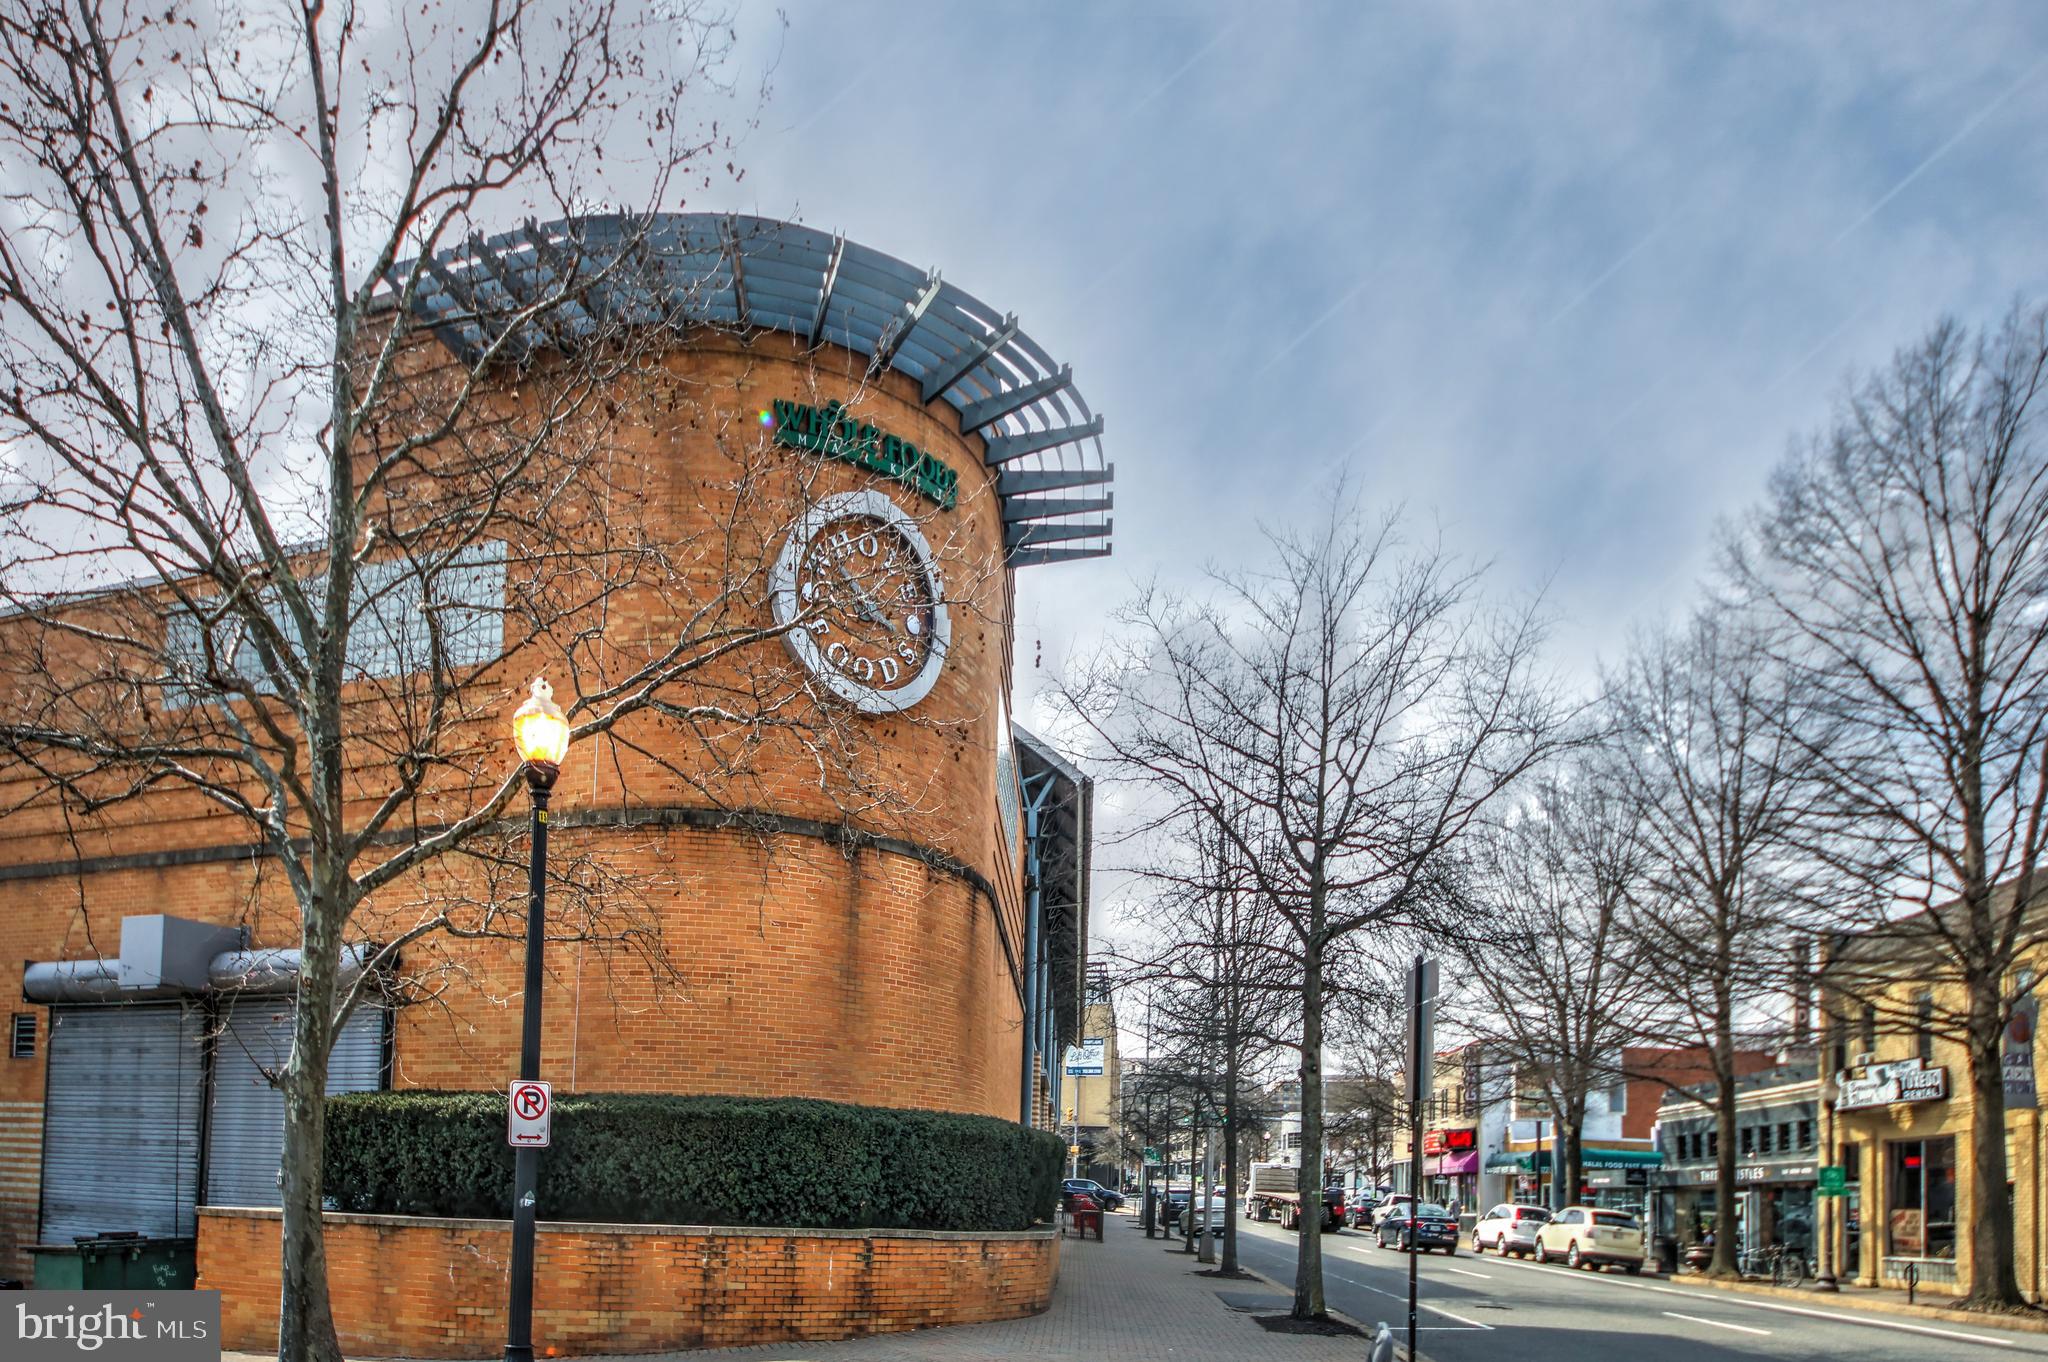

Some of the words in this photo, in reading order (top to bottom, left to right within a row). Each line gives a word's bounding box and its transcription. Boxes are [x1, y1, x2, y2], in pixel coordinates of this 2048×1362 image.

[773, 399, 881, 453] WHOLE
[882, 433, 958, 512] FOODS
[808, 618, 916, 684] FOODS
